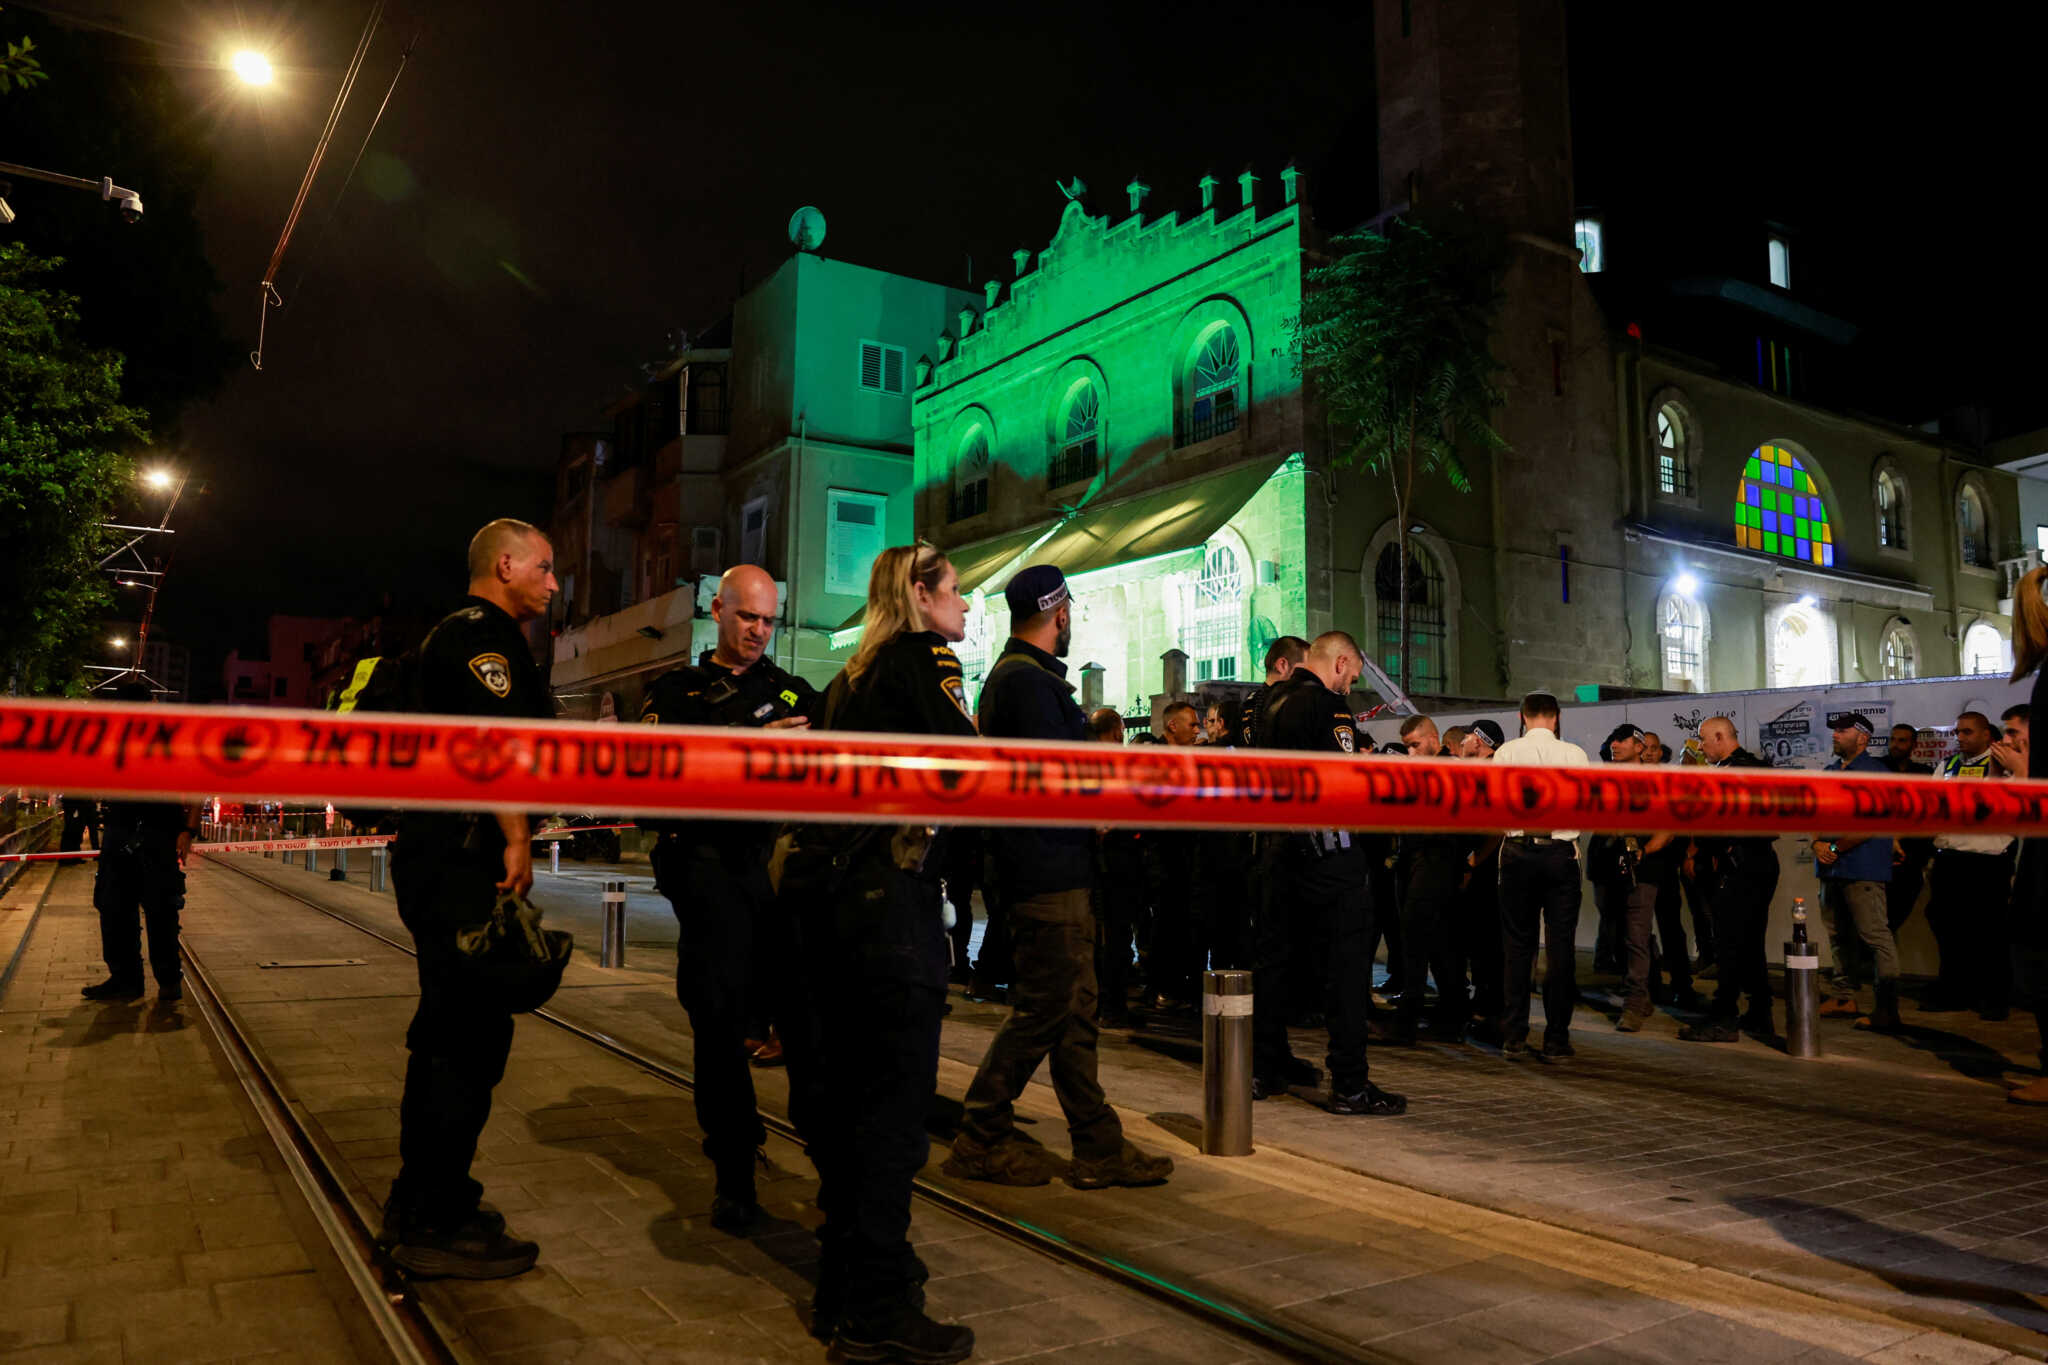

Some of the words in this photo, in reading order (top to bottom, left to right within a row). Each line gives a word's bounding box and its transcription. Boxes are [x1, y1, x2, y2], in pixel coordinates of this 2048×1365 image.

[0, 714, 109, 757] מעב
[114, 716, 182, 772] אין
[300, 721, 438, 769] ישראל
[528, 736, 686, 780] משטרת
[730, 743, 841, 783] מעבר
[992, 747, 1116, 796] ישראל
[1193, 762, 1321, 804] משטרת
[1353, 766, 1444, 805] מעבר
[1449, 772, 1493, 817] אין
[1558, 769, 1660, 812] ישראל
